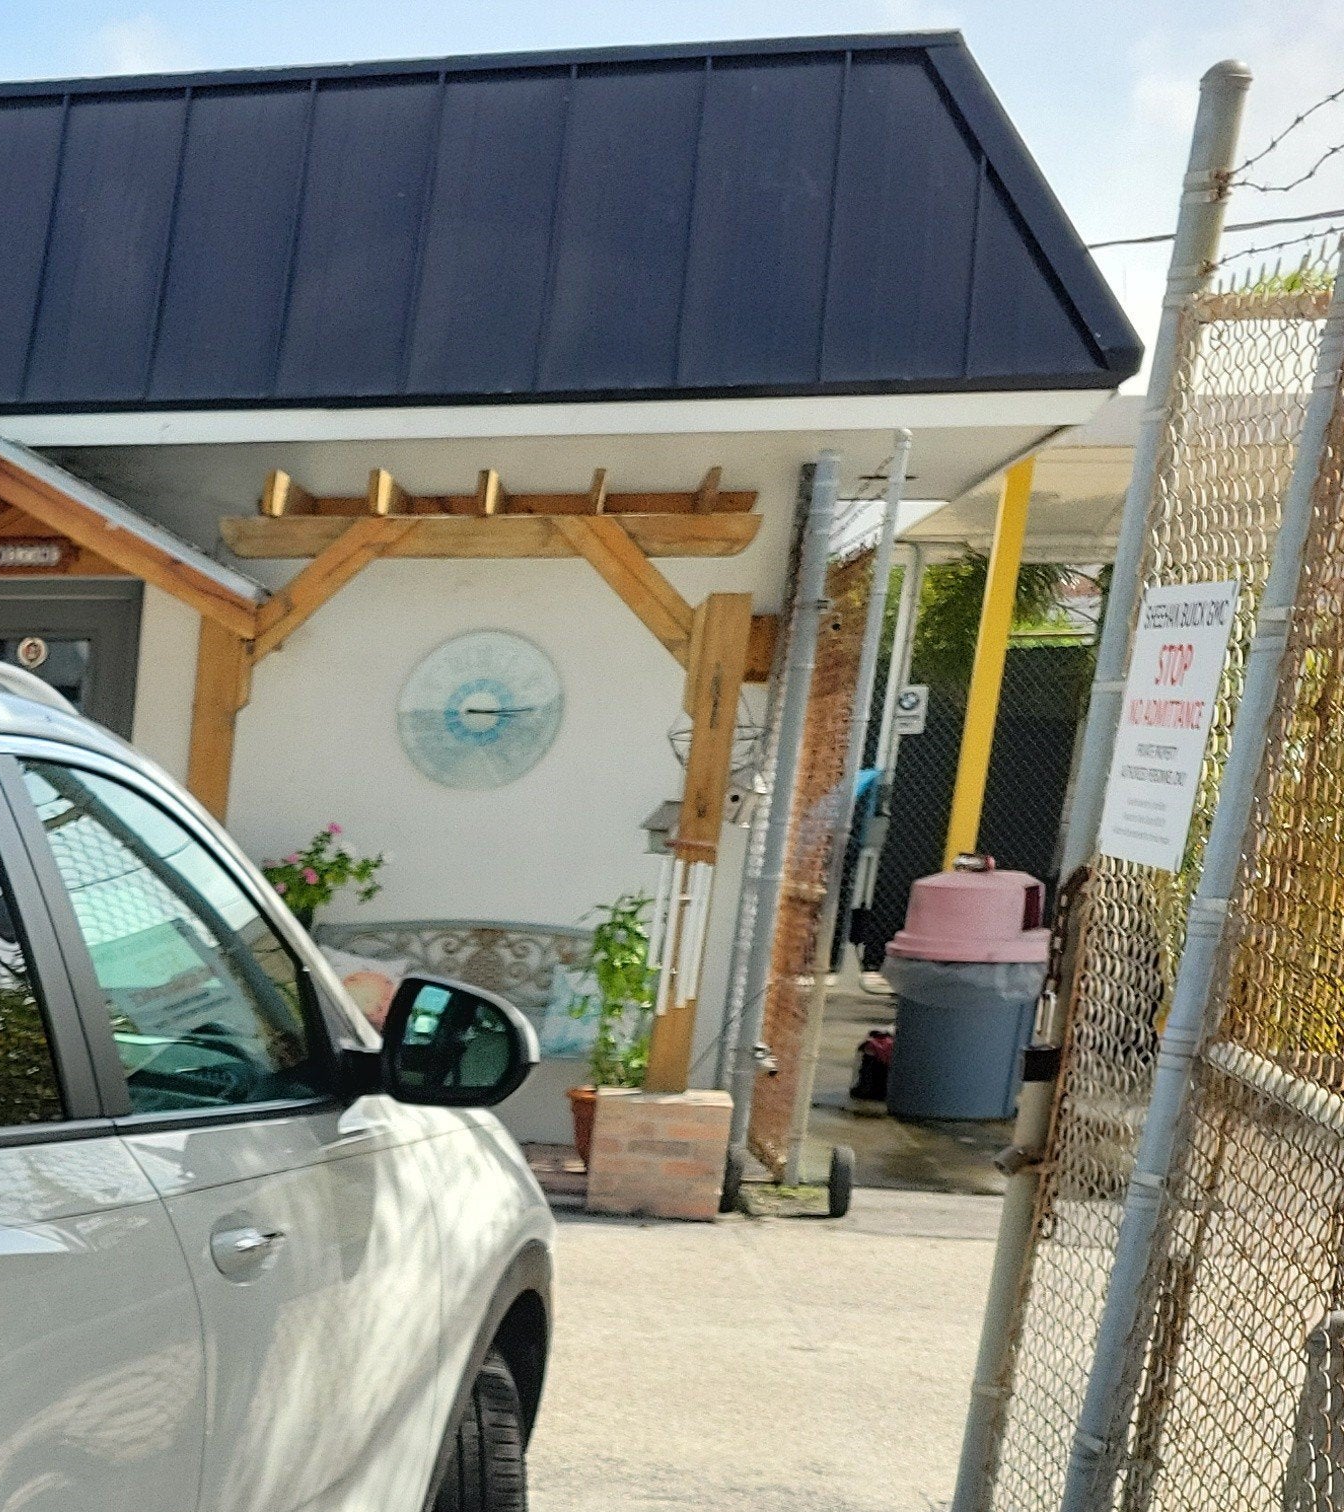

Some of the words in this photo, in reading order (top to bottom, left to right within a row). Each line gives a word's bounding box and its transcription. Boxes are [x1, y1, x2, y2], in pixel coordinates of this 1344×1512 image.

[1143, 602, 1181, 629] SHEEHAN
[1179, 600, 1207, 627] BUICK
[1205, 598, 1230, 626] GMC
[1153, 643, 1195, 686] STOP
[1126, 699, 1144, 724] NO
[1141, 699, 1205, 730] ADMITTANCE
